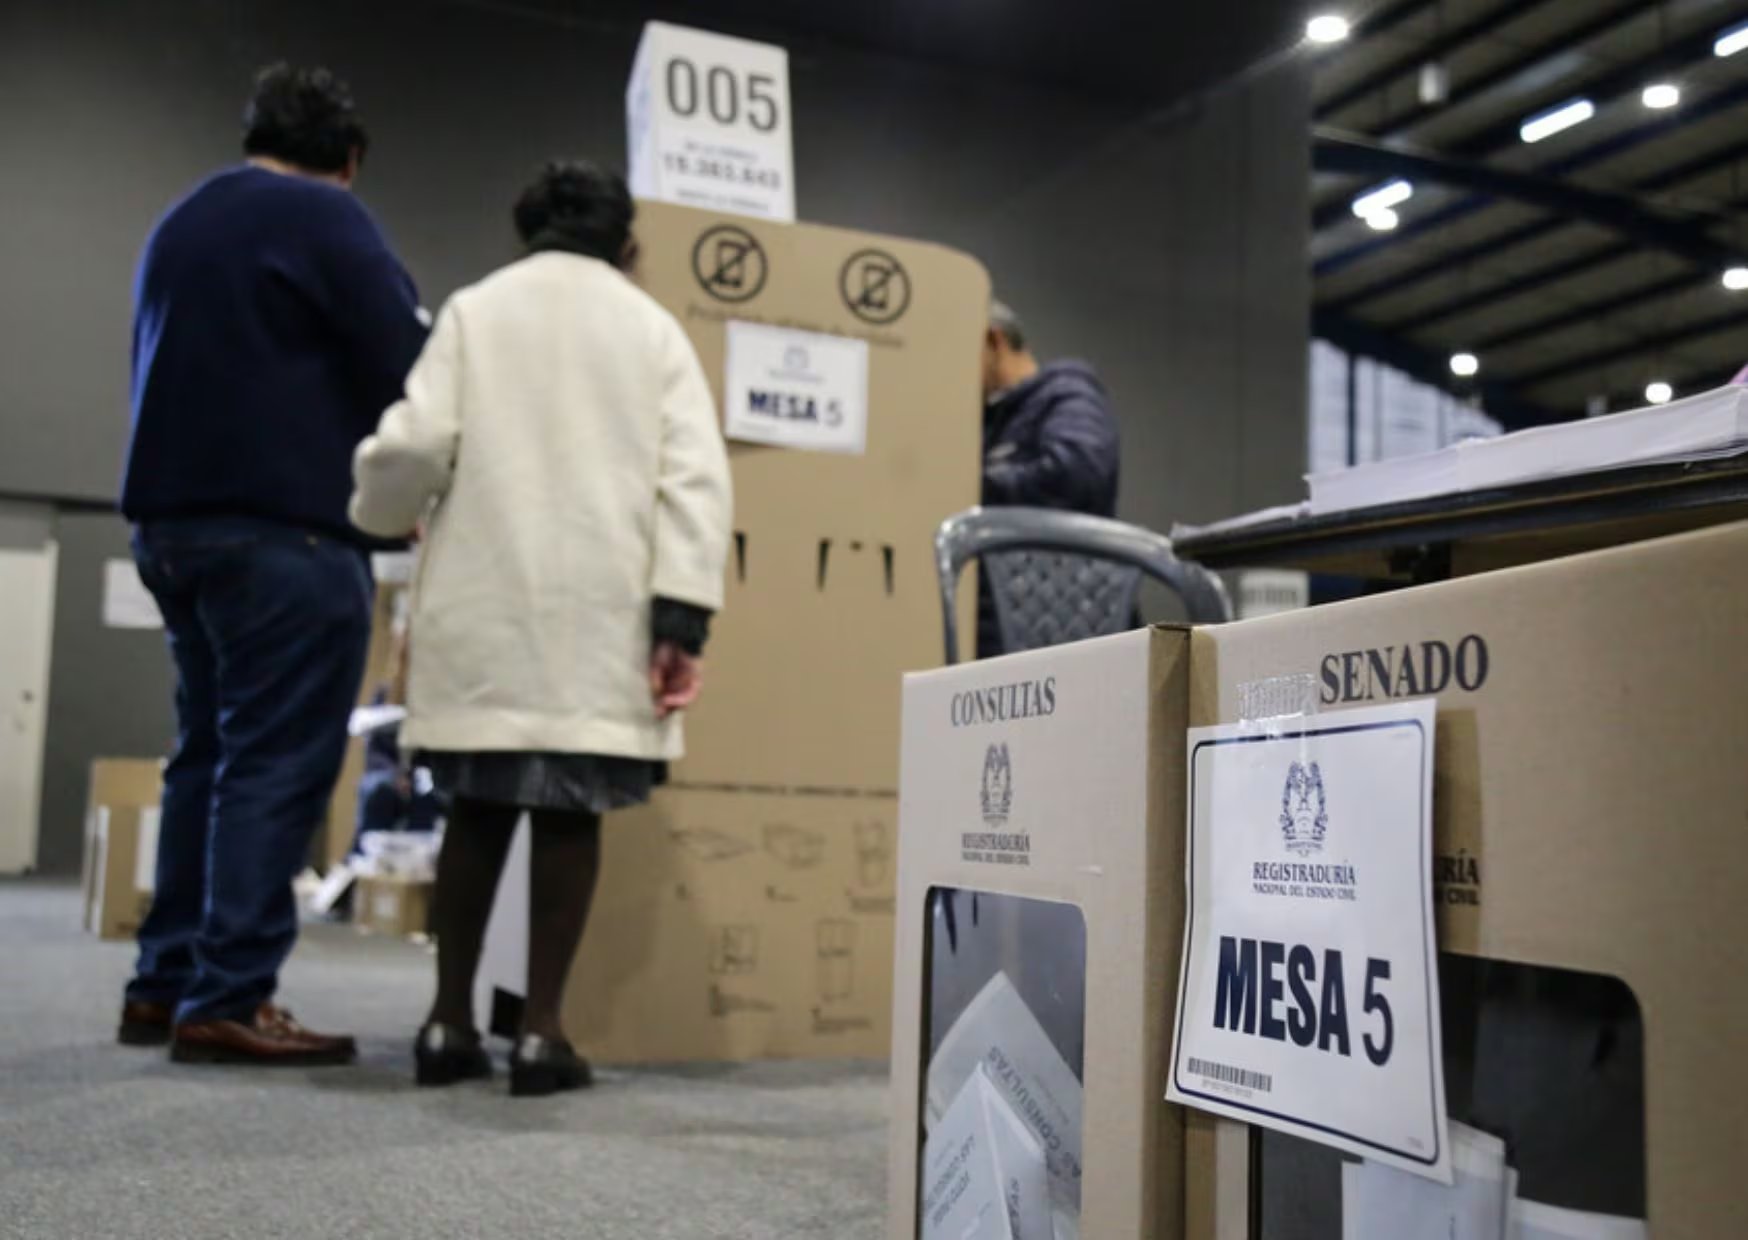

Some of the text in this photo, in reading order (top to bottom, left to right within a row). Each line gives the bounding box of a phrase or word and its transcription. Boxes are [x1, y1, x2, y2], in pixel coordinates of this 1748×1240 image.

[666, 57, 778, 133] 005
[747, 389, 845, 429] MESA 5
[1320, 634, 1489, 704] SENADO
[951, 677, 1056, 727] CONSULTAS
[1252, 859, 1356, 884] REGISTRADURÍA
[1213, 935, 1394, 1066] MESA 5
